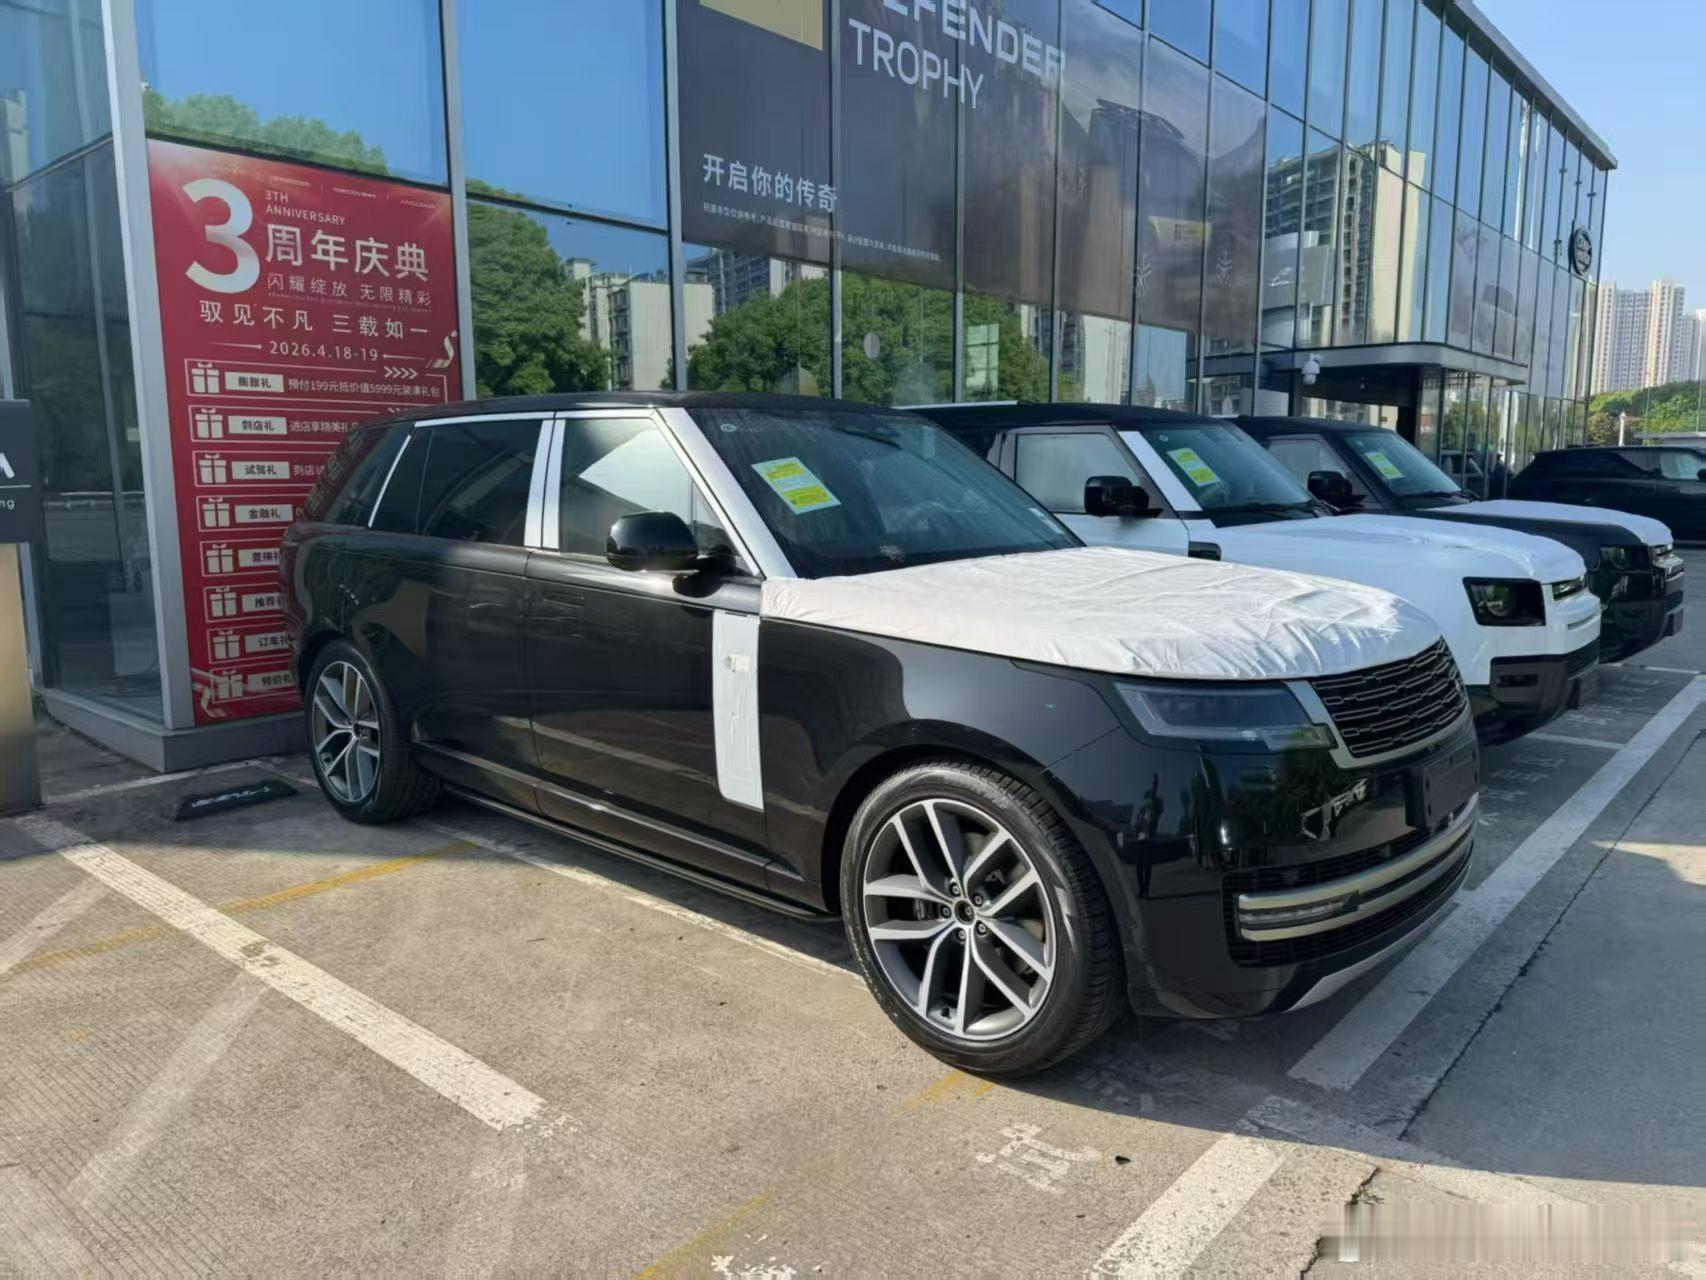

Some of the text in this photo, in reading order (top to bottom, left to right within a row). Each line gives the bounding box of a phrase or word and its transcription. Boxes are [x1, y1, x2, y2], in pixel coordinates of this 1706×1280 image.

[849, 18, 984, 109] TROPHY
[265, 190, 289, 203] 3TH
[703, 153, 837, 213] 开启你的传奇
[265, 205, 346, 226] ANNIVERSARY
[182, 178, 261, 294] 3
[265, 223, 429, 282] 周年庆典
[267, 272, 348, 297] 闪耀绽放
[360, 284, 432, 307] 无限精彩
[200, 300, 313, 331] 驭见不凡
[332, 314, 428, 339] 三载如一
[269, 341, 379, 361] 2026.4.18-19
[242, 420, 275, 431] 到店礼
[245, 464, 277, 475] 试驾礼
[248, 508, 281, 519] 金融礼
